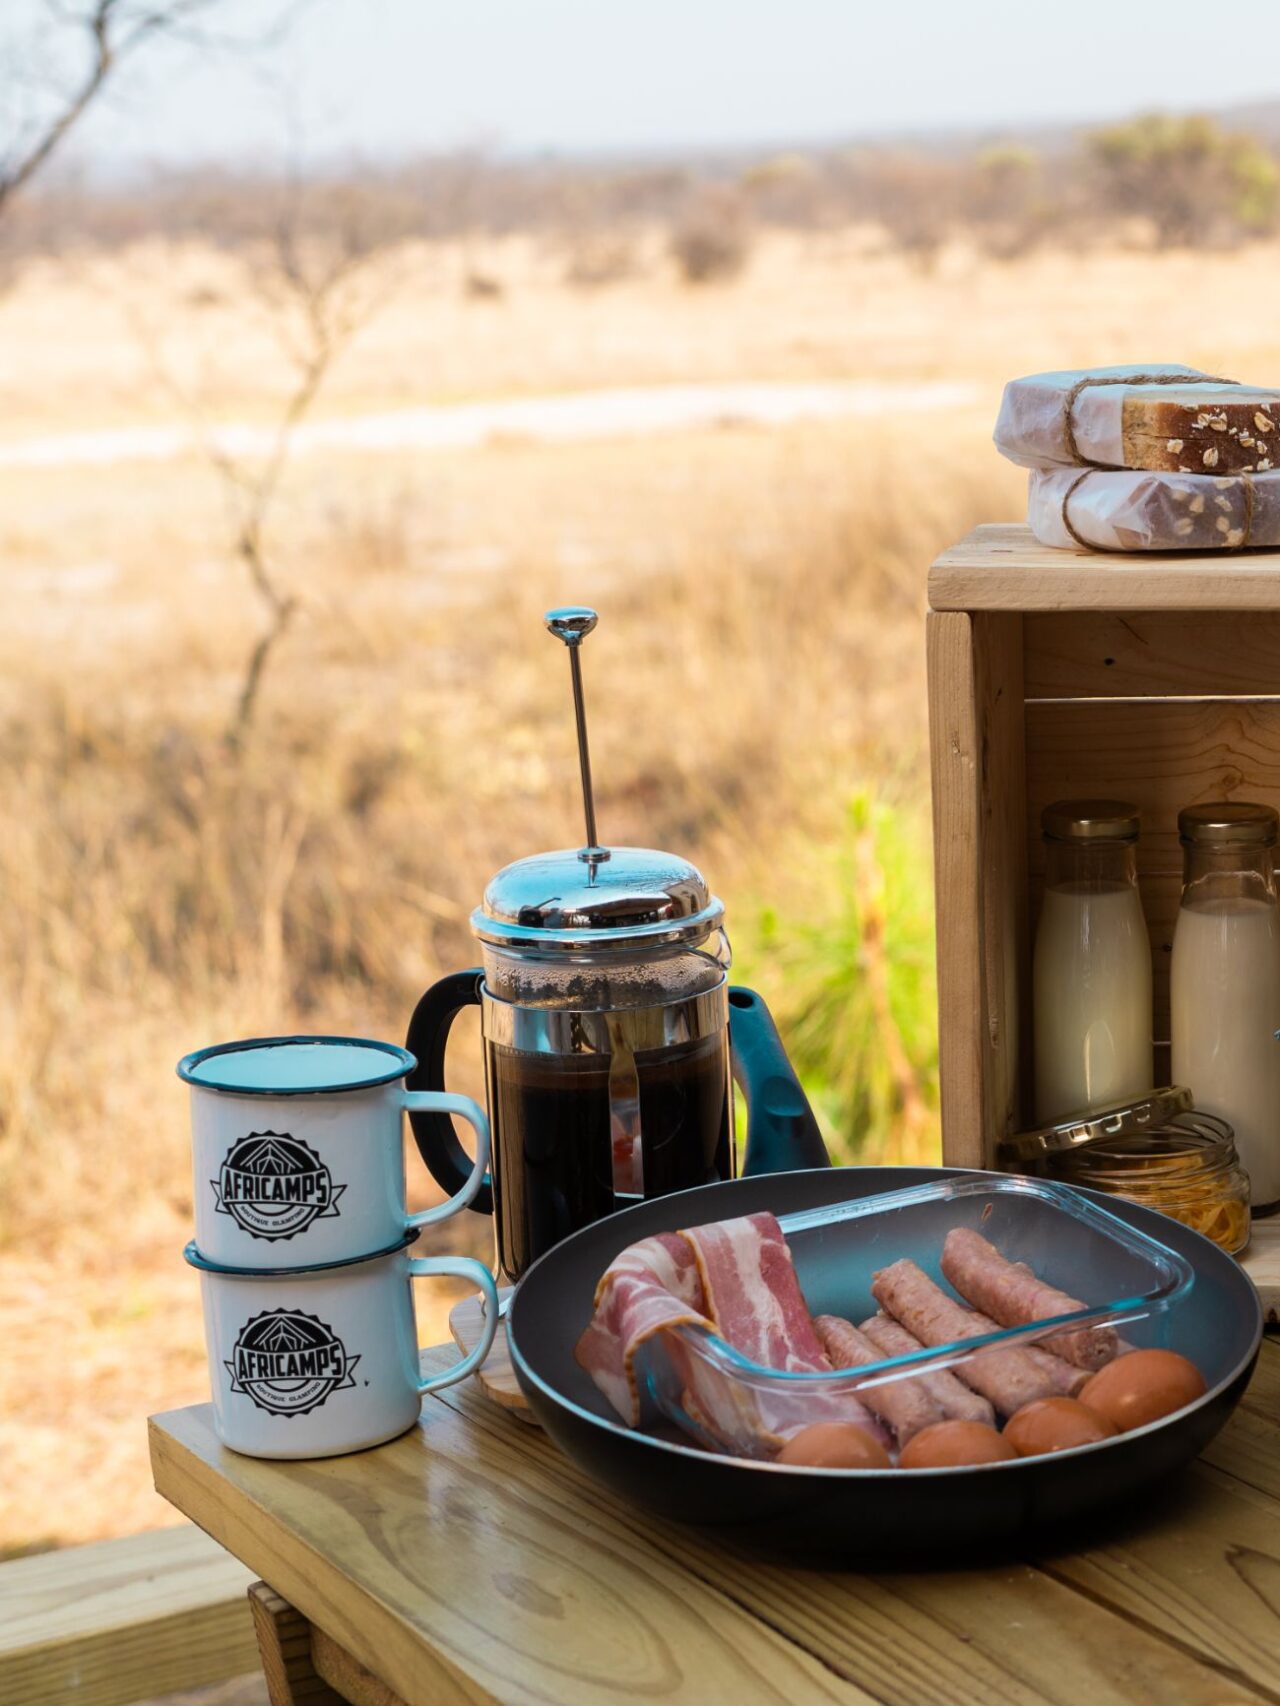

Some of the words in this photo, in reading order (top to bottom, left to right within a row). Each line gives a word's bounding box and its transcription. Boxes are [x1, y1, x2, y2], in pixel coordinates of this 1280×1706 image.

[223, 1168, 327, 1204] AFRICAMPS
[240, 1205, 269, 1226] BOUTIQUE
[272, 1207, 305, 1227] GLAMPING
[238, 1344, 342, 1380] AFRICAMPS
[255, 1383, 285, 1402] BOUTIQUE
[288, 1381, 321, 1402] GLAMPING
